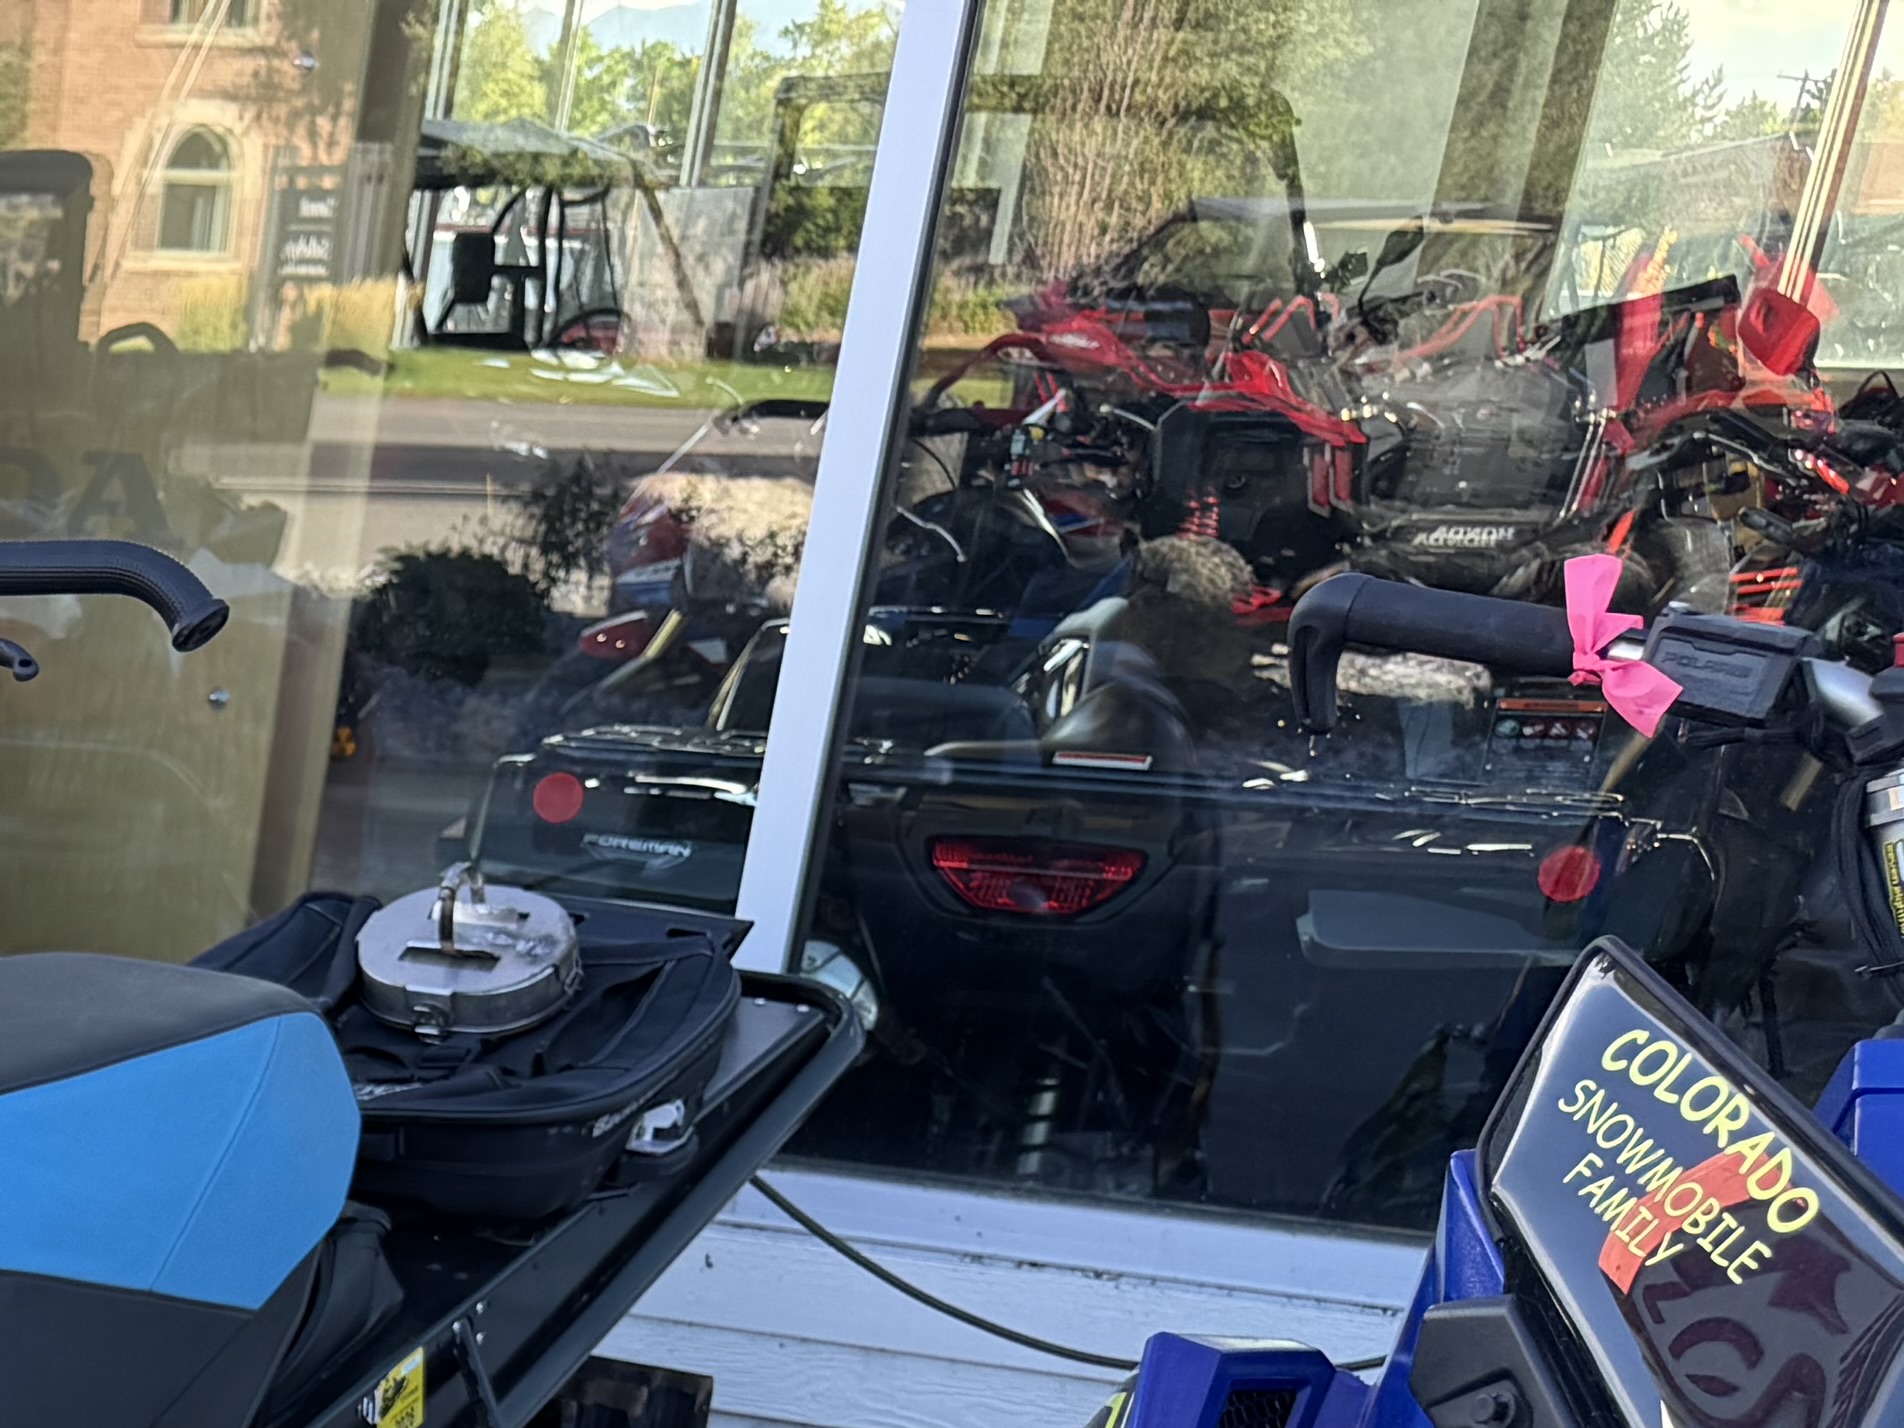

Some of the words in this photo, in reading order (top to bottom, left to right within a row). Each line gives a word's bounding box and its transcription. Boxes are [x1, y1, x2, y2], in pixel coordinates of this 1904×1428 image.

[1557, 1079, 1772, 1285] SNOWMOBILE
[1562, 1152, 1685, 1267] FAMILY
[1601, 1029, 1819, 1234] COLORADO
